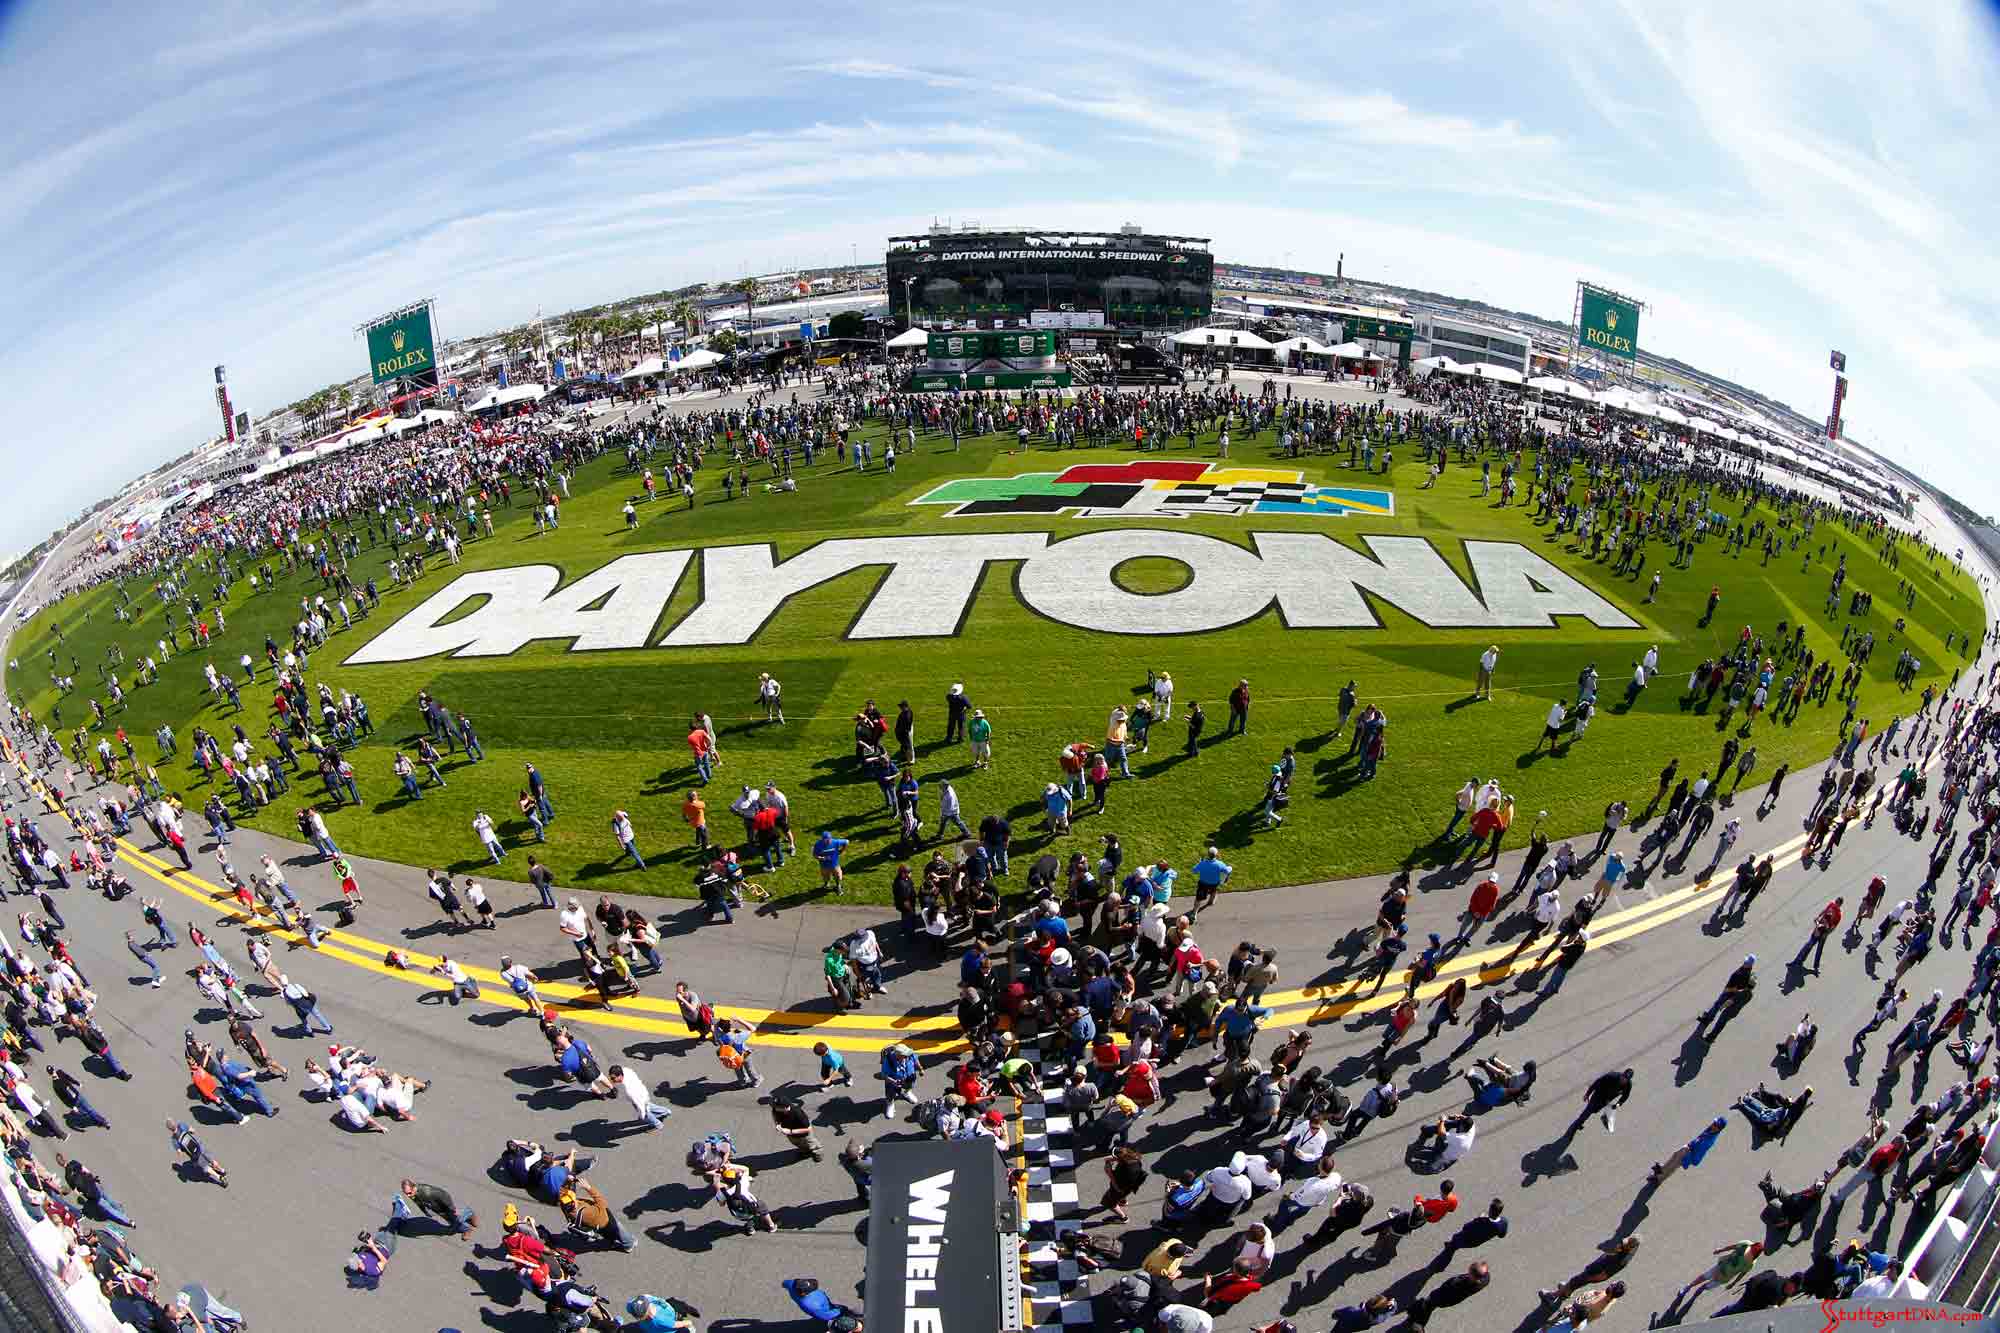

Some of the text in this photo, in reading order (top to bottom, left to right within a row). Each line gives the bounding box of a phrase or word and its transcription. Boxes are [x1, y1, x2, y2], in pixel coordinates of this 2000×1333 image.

[942, 250, 1163, 262] DAYTONA INTERNATIONAL SPEEDWAY
[1587, 328, 1631, 352] ROLEX
[379, 348, 427, 376] ROLEX
[343, 530, 1642, 666] DAYTONA
